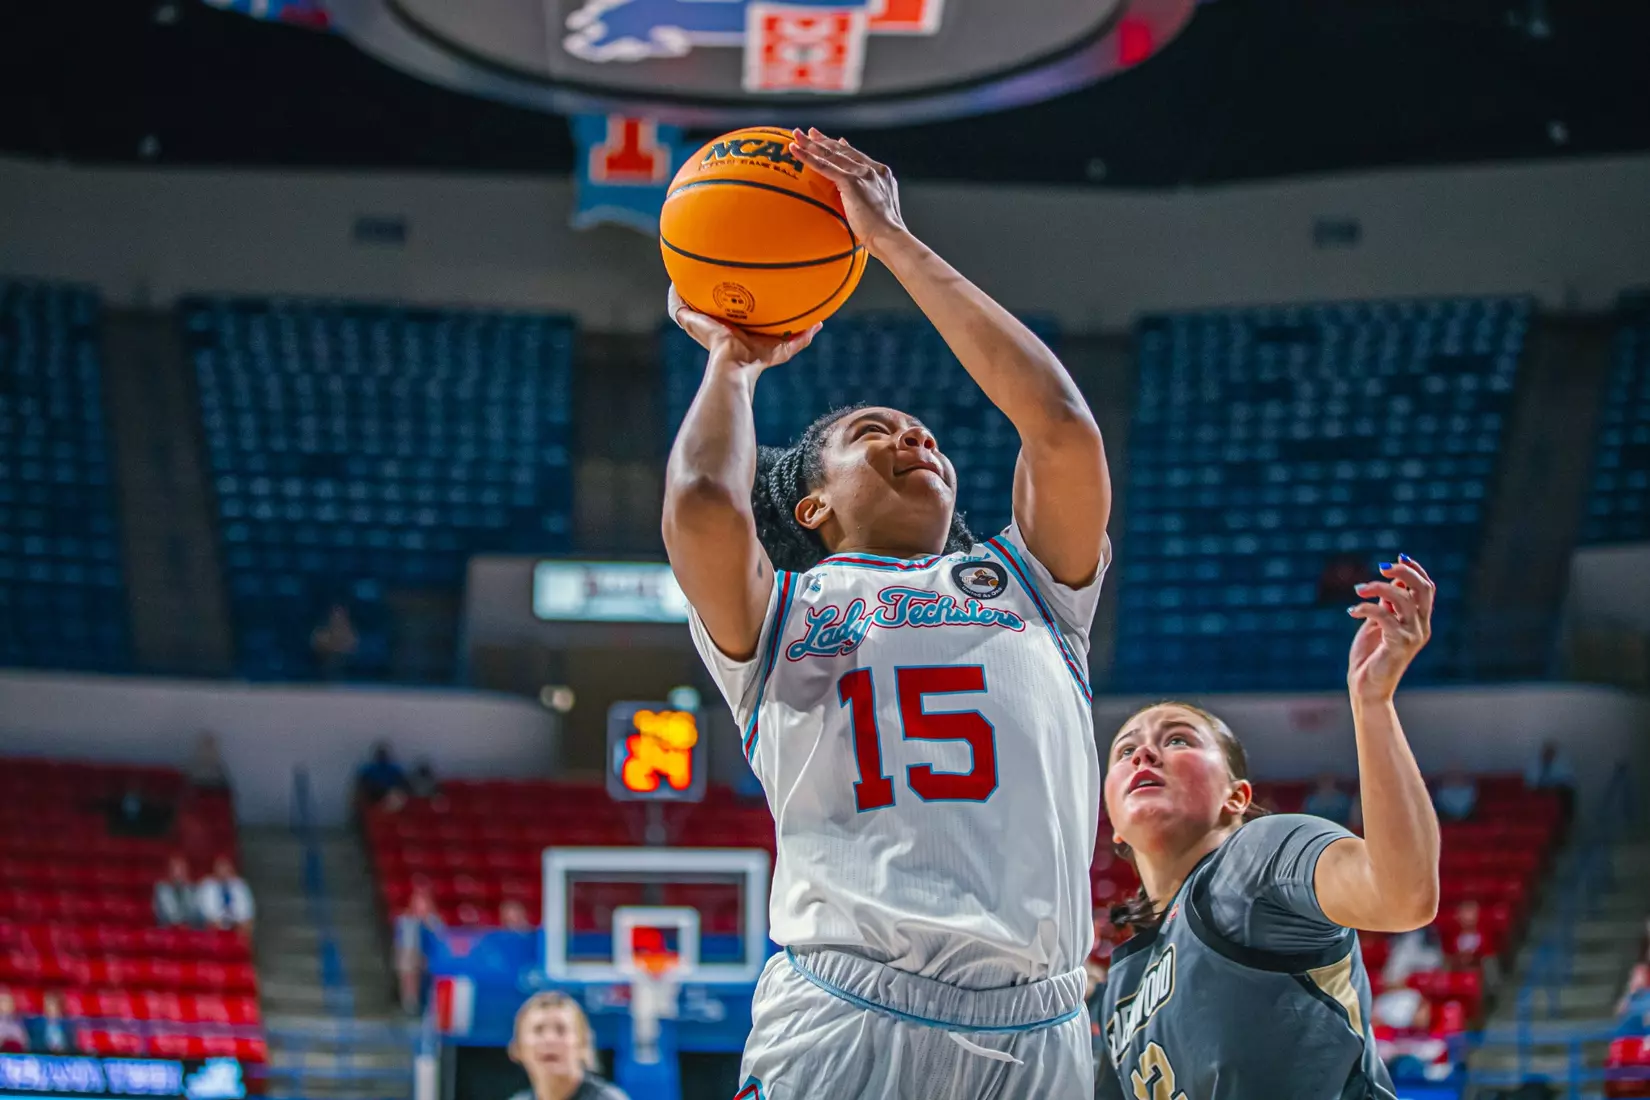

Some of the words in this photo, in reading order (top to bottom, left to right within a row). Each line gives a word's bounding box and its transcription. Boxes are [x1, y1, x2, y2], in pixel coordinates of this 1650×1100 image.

[700, 138, 804, 173] NCAA
[786, 597, 874, 661] Lady
[871, 586, 1026, 633] Techsters
[837, 664, 999, 813] 15
